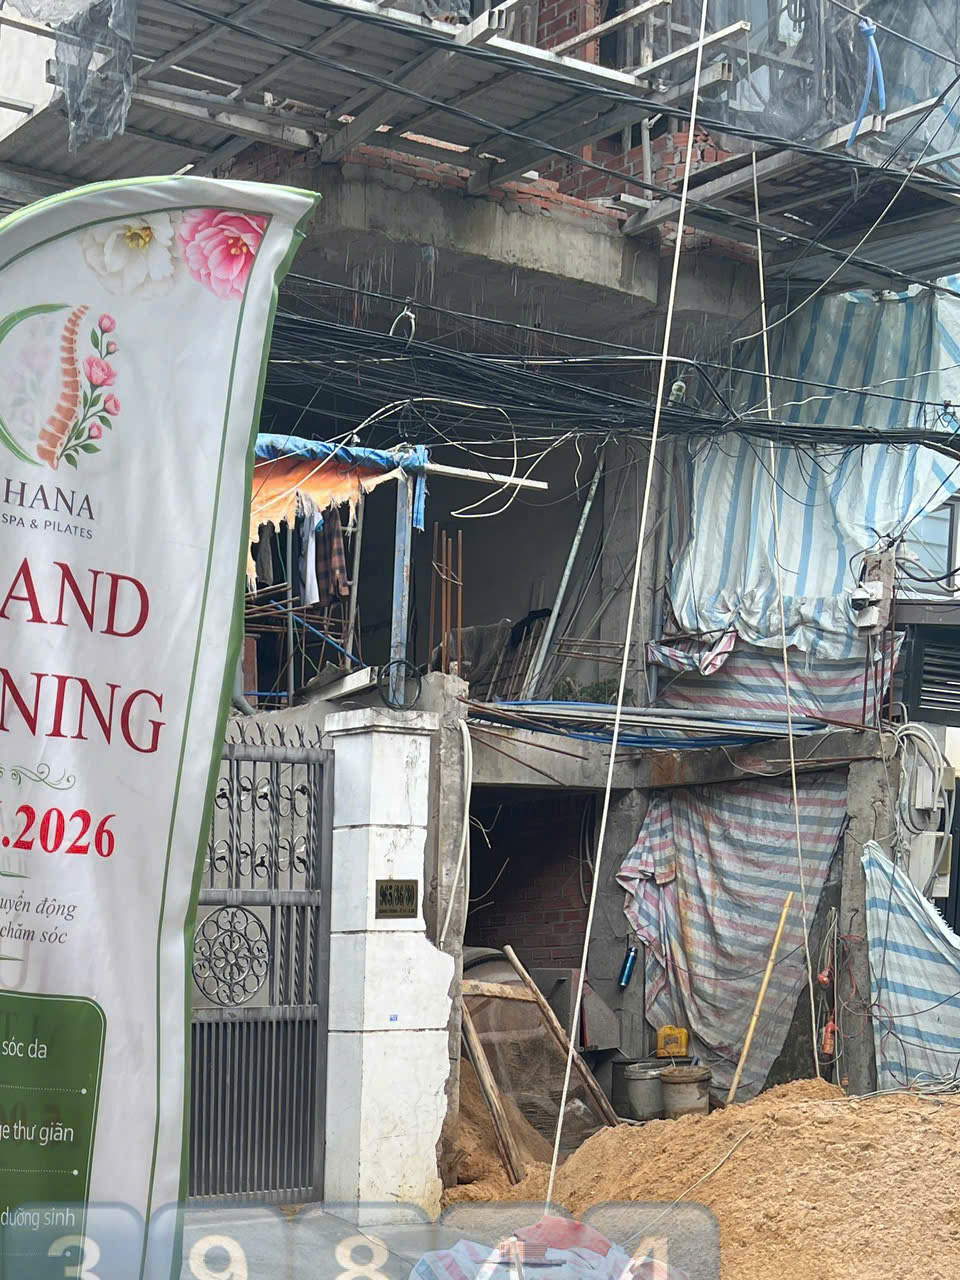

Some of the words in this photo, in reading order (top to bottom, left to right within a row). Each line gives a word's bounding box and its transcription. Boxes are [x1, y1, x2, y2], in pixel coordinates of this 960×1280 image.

[3, 478, 95, 520] HANA
[1, 513, 26, 529] SPA
[29, 518, 39, 530] &
[43, 520, 94, 540] PILATES
[35, 898, 78, 920] động
[0, 922, 35, 942] chăm
[41, 926, 68, 944] sóc
[2, 1035, 24, 1058] sóc
[28, 1038, 48, 1059] da
[13, 1120, 37, 1141] thư
[39, 1121, 74, 1145] giãn
[0, 1207, 39, 1231] dưỡng
[43, 1207, 75, 1227] sinh
